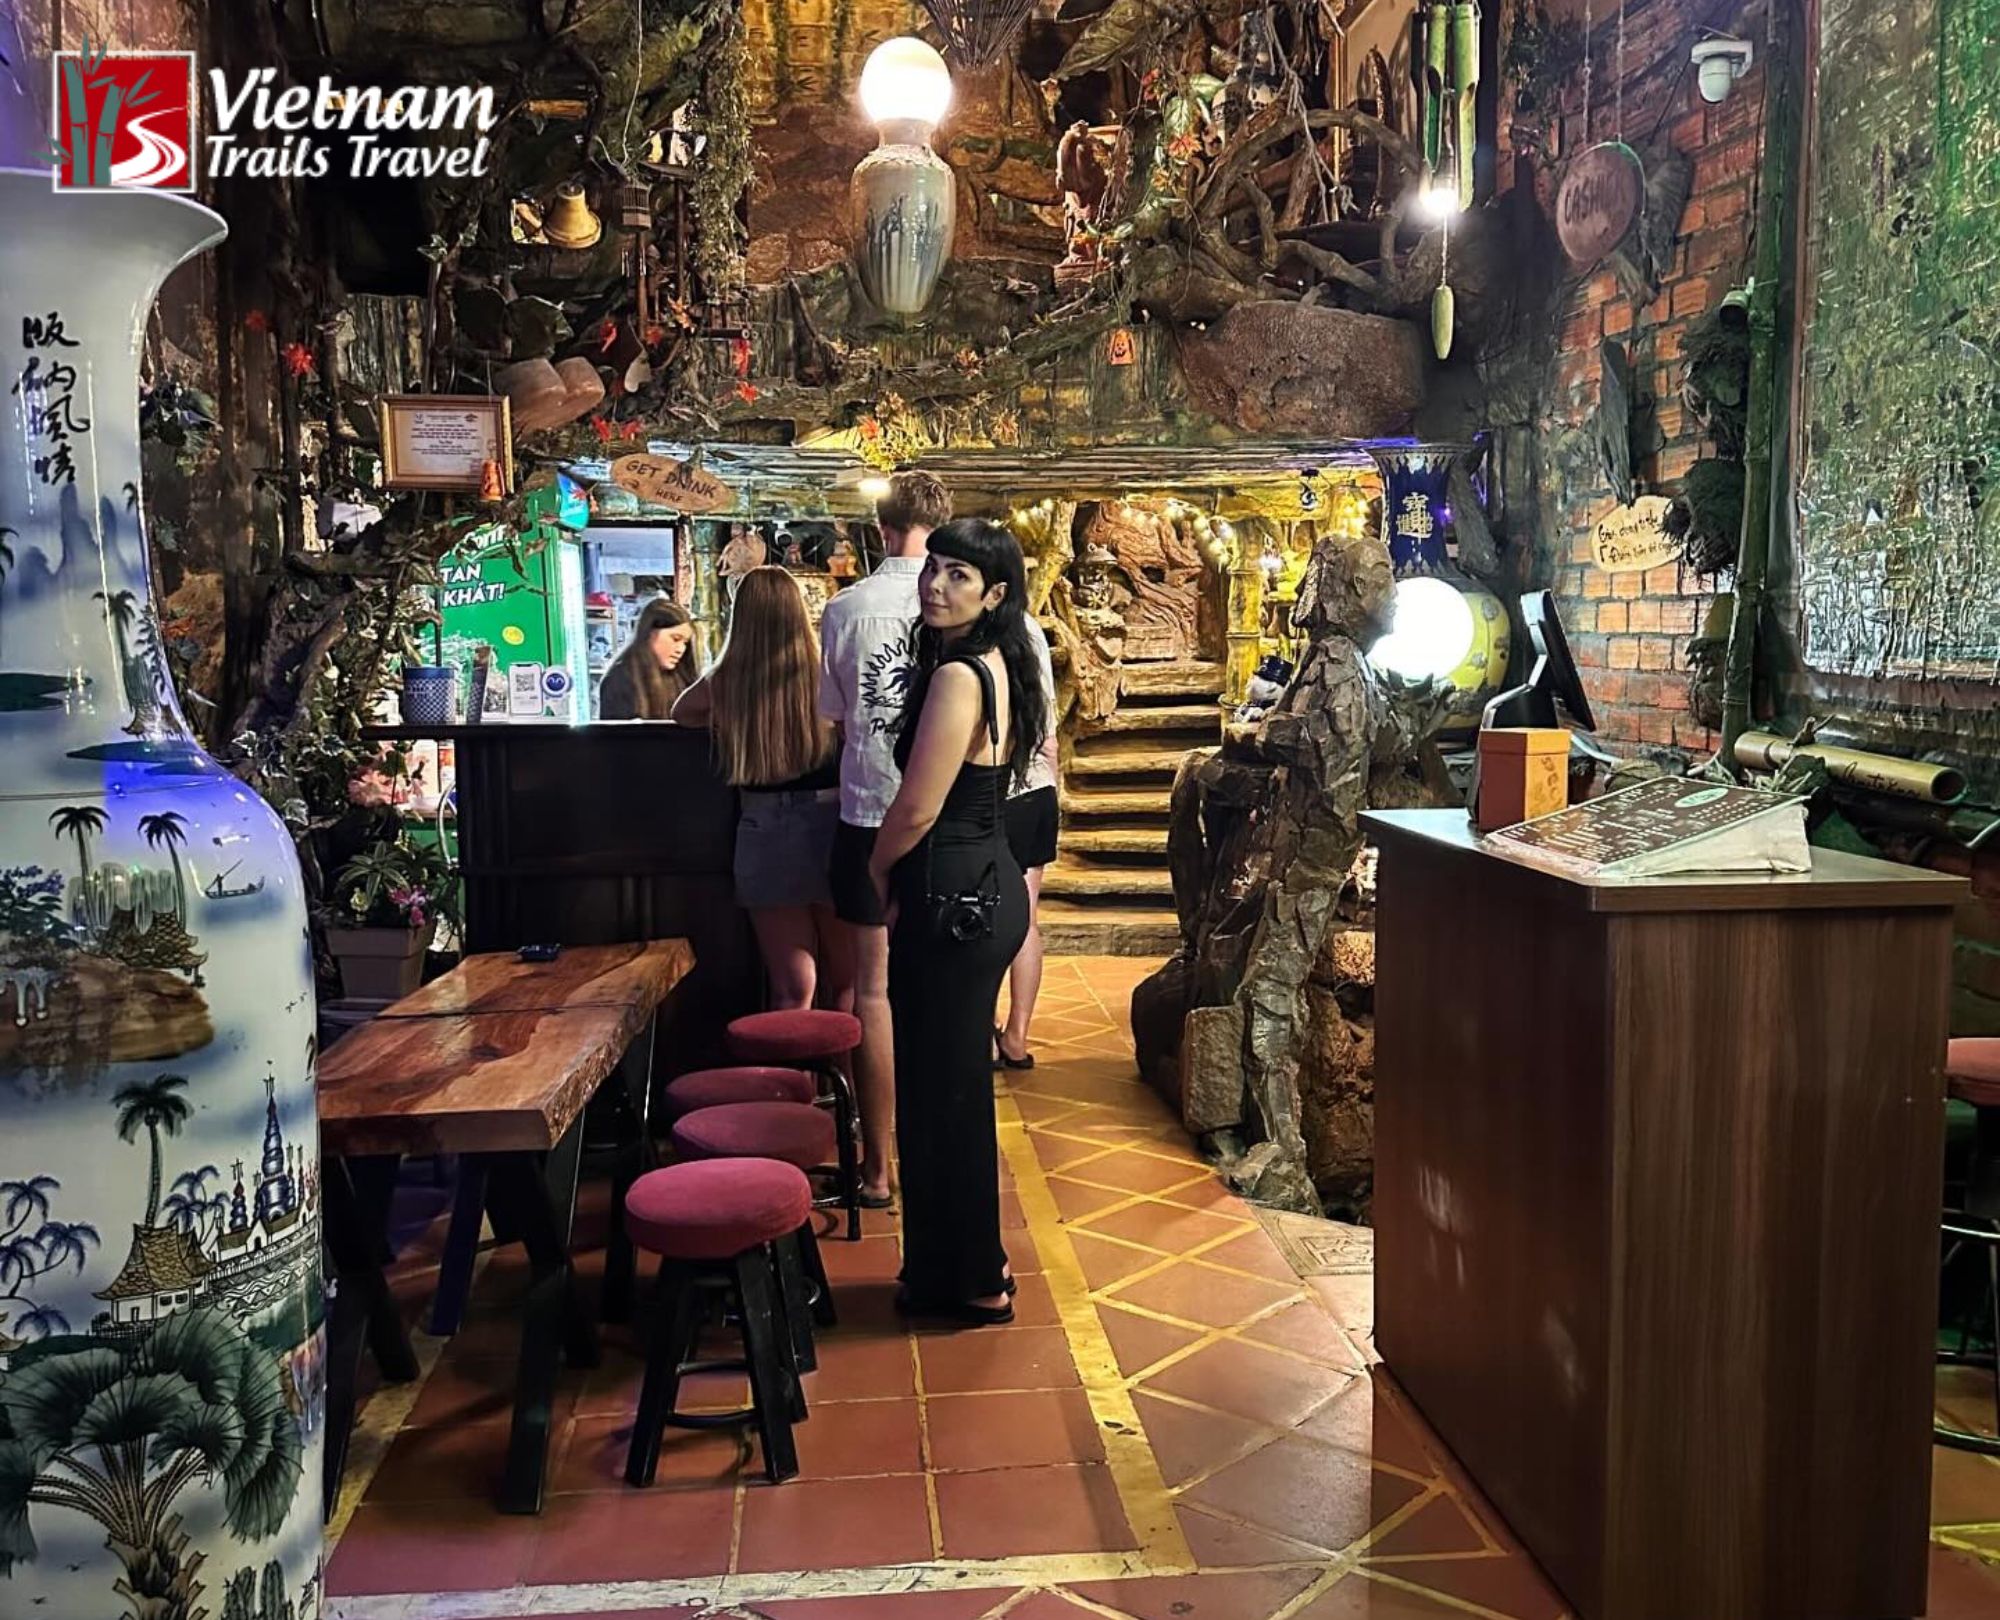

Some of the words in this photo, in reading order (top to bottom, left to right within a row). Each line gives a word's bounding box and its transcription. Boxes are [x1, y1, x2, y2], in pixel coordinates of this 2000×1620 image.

[626, 460, 661, 478] GET
[440, 563, 482, 584] TAN
[443, 580, 505, 607] KHÁT!
